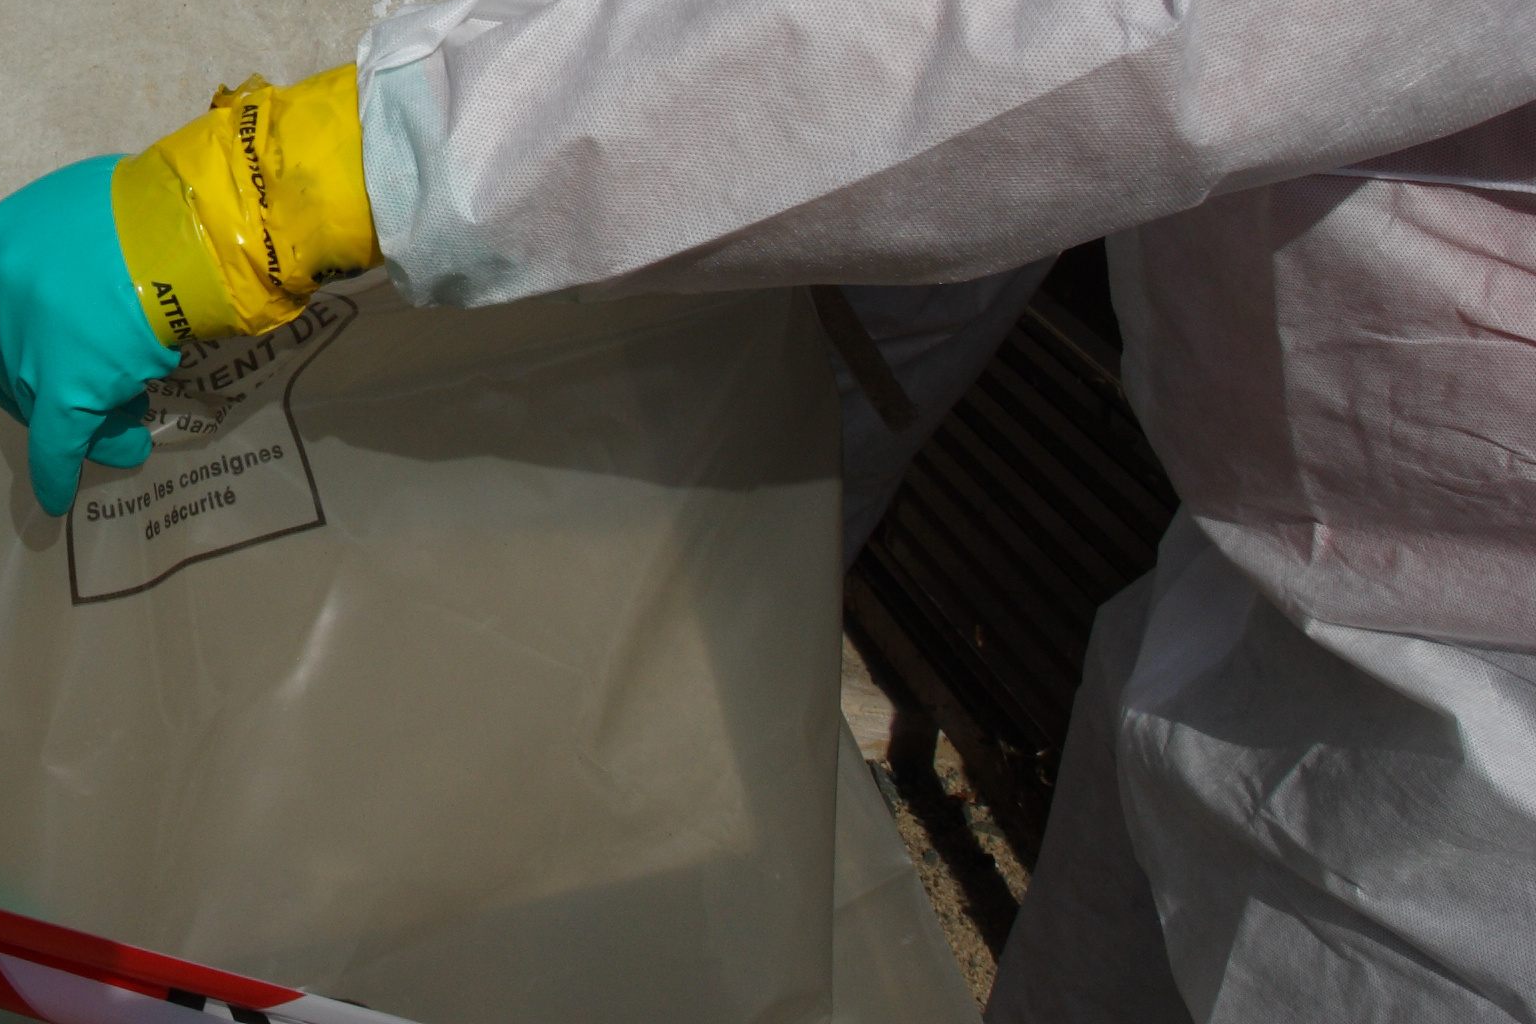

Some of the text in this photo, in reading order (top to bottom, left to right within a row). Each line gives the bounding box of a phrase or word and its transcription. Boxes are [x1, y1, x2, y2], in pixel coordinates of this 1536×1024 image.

[86, 443, 285, 522] Suivre les consignes
[144, 485, 237, 541] de sécurité
